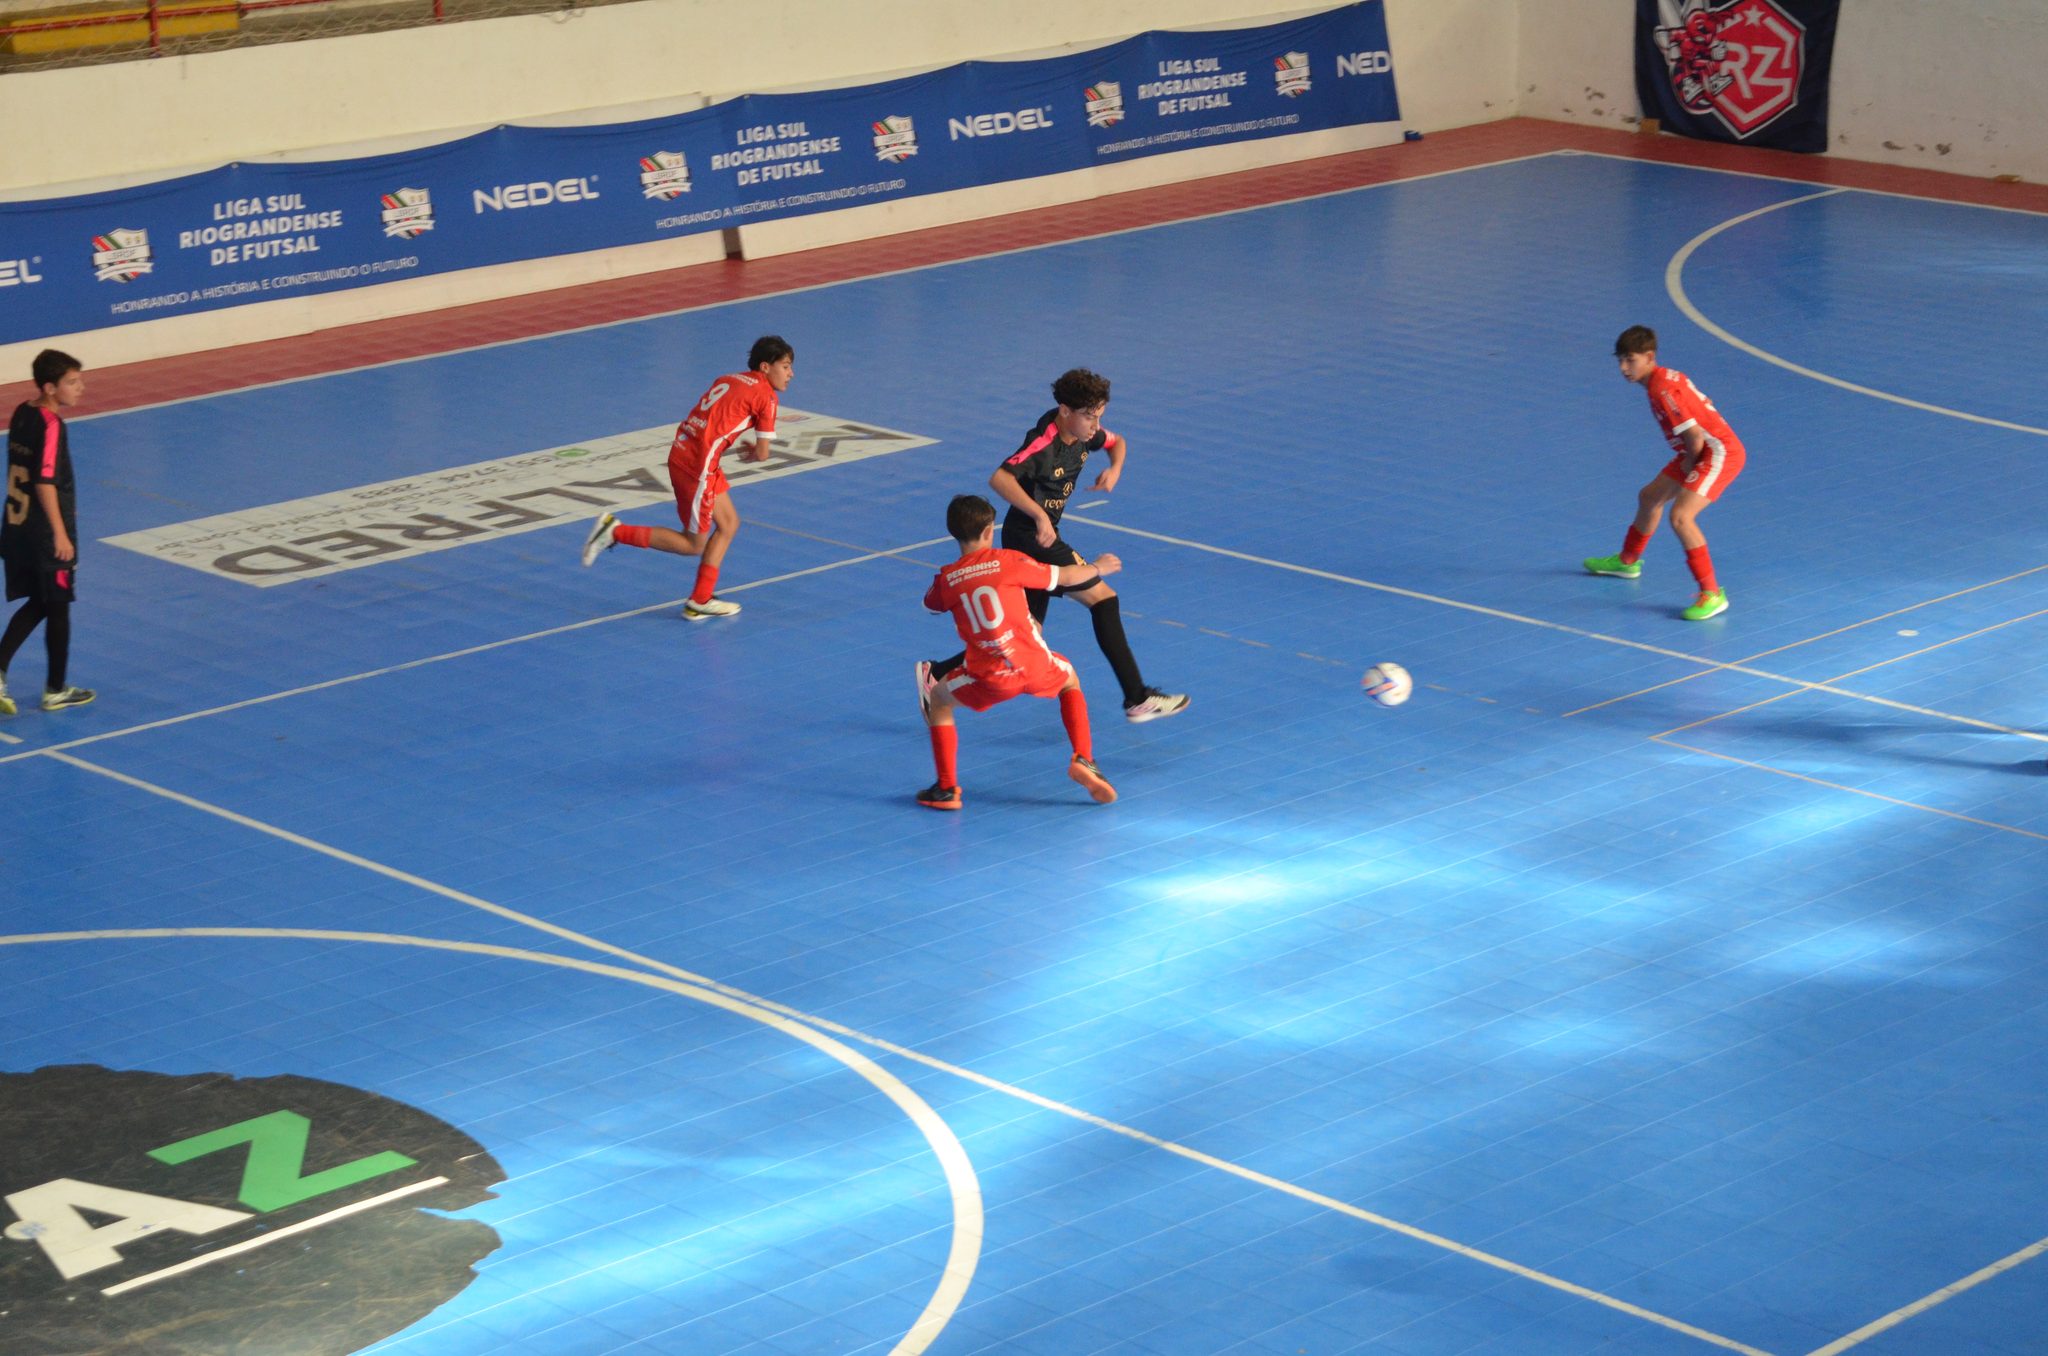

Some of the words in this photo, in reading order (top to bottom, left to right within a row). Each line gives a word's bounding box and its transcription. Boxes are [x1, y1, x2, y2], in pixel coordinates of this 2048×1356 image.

[1158, 59, 1194, 77] LIGA
[1194, 57, 1221, 71] SUL
[1138, 72, 1247, 100] RIOGRANDENSE
[1158, 100, 1178, 116] DE
[1179, 92, 1232, 113] FUTSAL
[736, 125, 777, 145] LIGA
[777, 121, 809, 138] SUL
[948, 106, 1054, 141] NEDEL
[711, 136, 841, 171] RIOGRANDENSE
[737, 169, 761, 186] DE
[762, 159, 824, 181] FUTSAL
[213, 197, 264, 221] LIGA
[266, 193, 306, 213] SUL
[473, 177, 600, 214] NEDEL
[179, 210, 343, 249] RIOGRANDENSE
[211, 248, 240, 266] DE
[242, 235, 320, 261] FUTSAL
[112, 291, 189, 314] HONRANDO
[191, 290, 202, 301] A
[261, 280, 270, 290] E
[272, 265, 359, 288] CONSTRUINDO
[360, 264, 371, 275] O
[372, 256, 419, 274] FUTURO
[700, 382, 730, 411] 9
[6, 464, 30, 526] 5
[946, 559, 1000, 582] PEDRINHO
[960, 585, 1004, 634] 10
